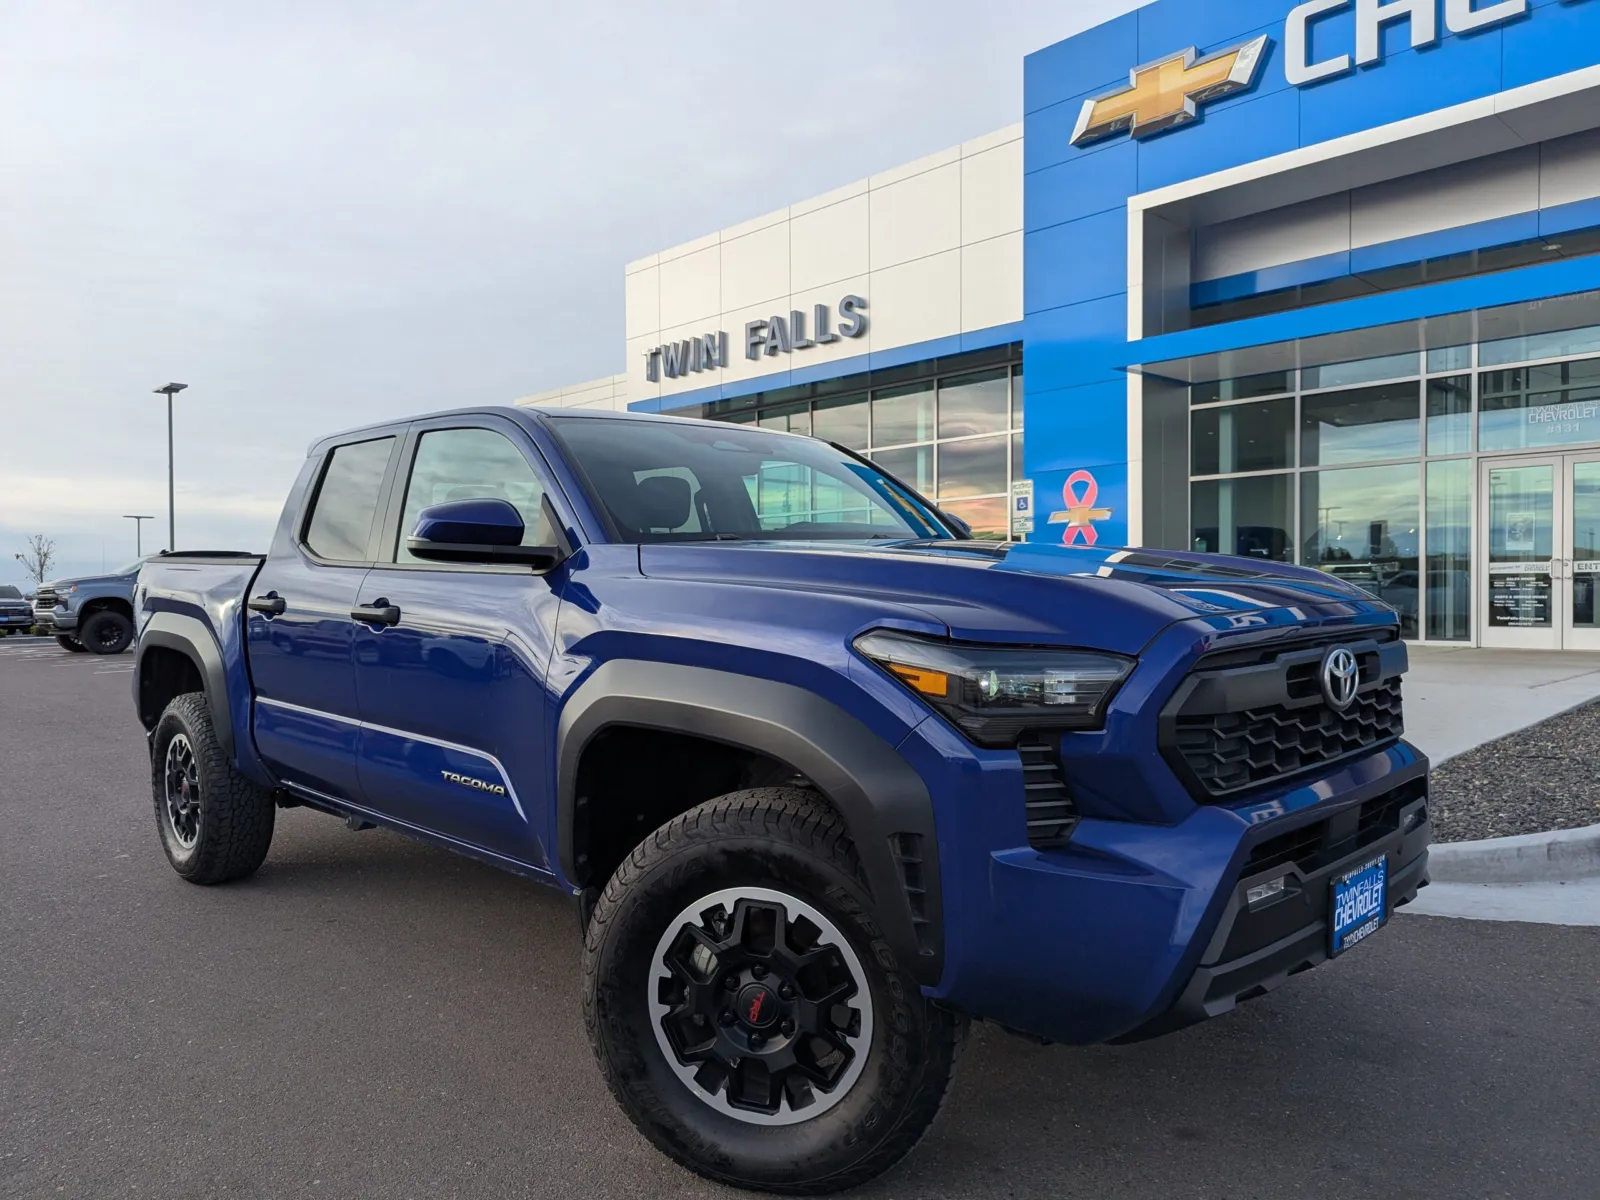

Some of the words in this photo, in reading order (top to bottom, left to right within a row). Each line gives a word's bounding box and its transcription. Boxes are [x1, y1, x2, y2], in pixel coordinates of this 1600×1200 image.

[642, 331, 728, 382] TWIN
[745, 295, 868, 361] FALLS
[1528, 406, 1597, 424] CHEVROLET
[441, 769, 505, 796] TACOMA
[1336, 870, 1384, 909] TWINFALLS
[1335, 883, 1384, 931] CHEVROLET
[1354, 917, 1379, 942] CHEVROLET
[749, 991, 767, 1023] TRD
